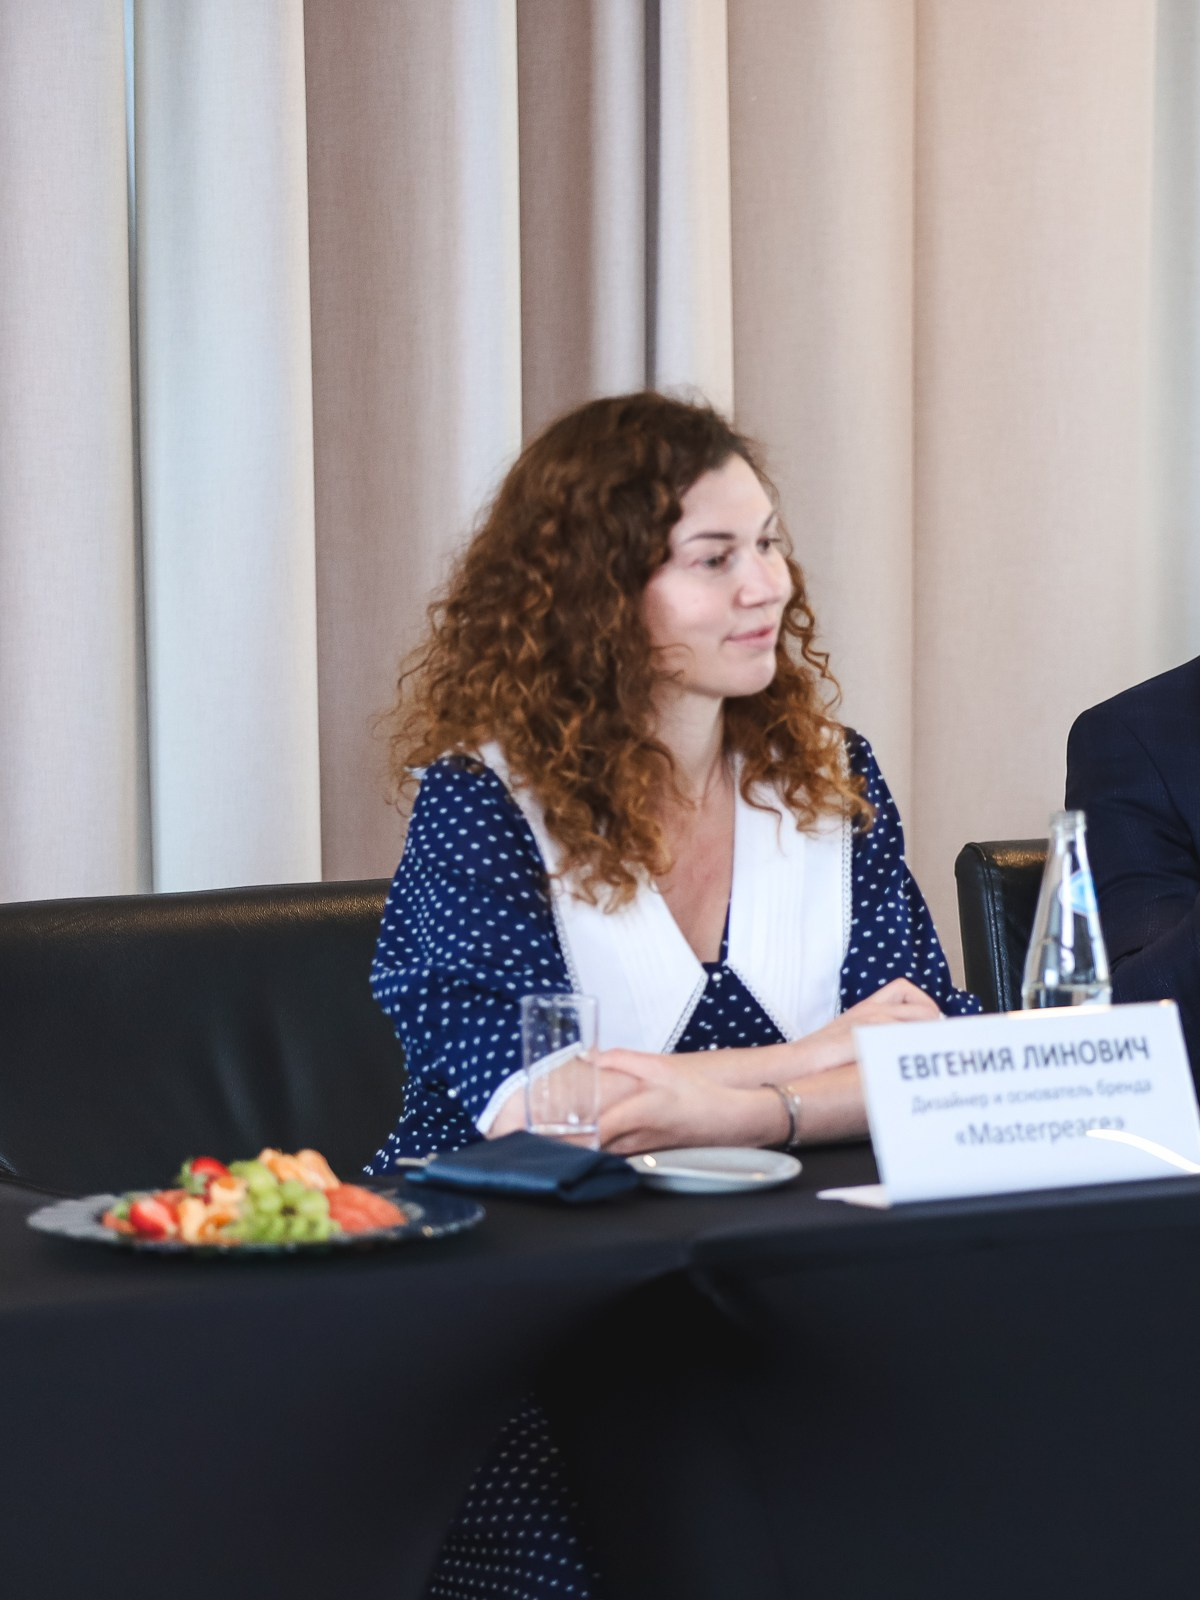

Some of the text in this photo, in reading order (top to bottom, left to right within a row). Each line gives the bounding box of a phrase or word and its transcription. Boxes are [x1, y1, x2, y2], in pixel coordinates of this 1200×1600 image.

[898, 1036, 1151, 1082] ЕВГЕНИЯ ЛИНОВИЧ
[911, 1092, 989, 1115] Дизайнер
